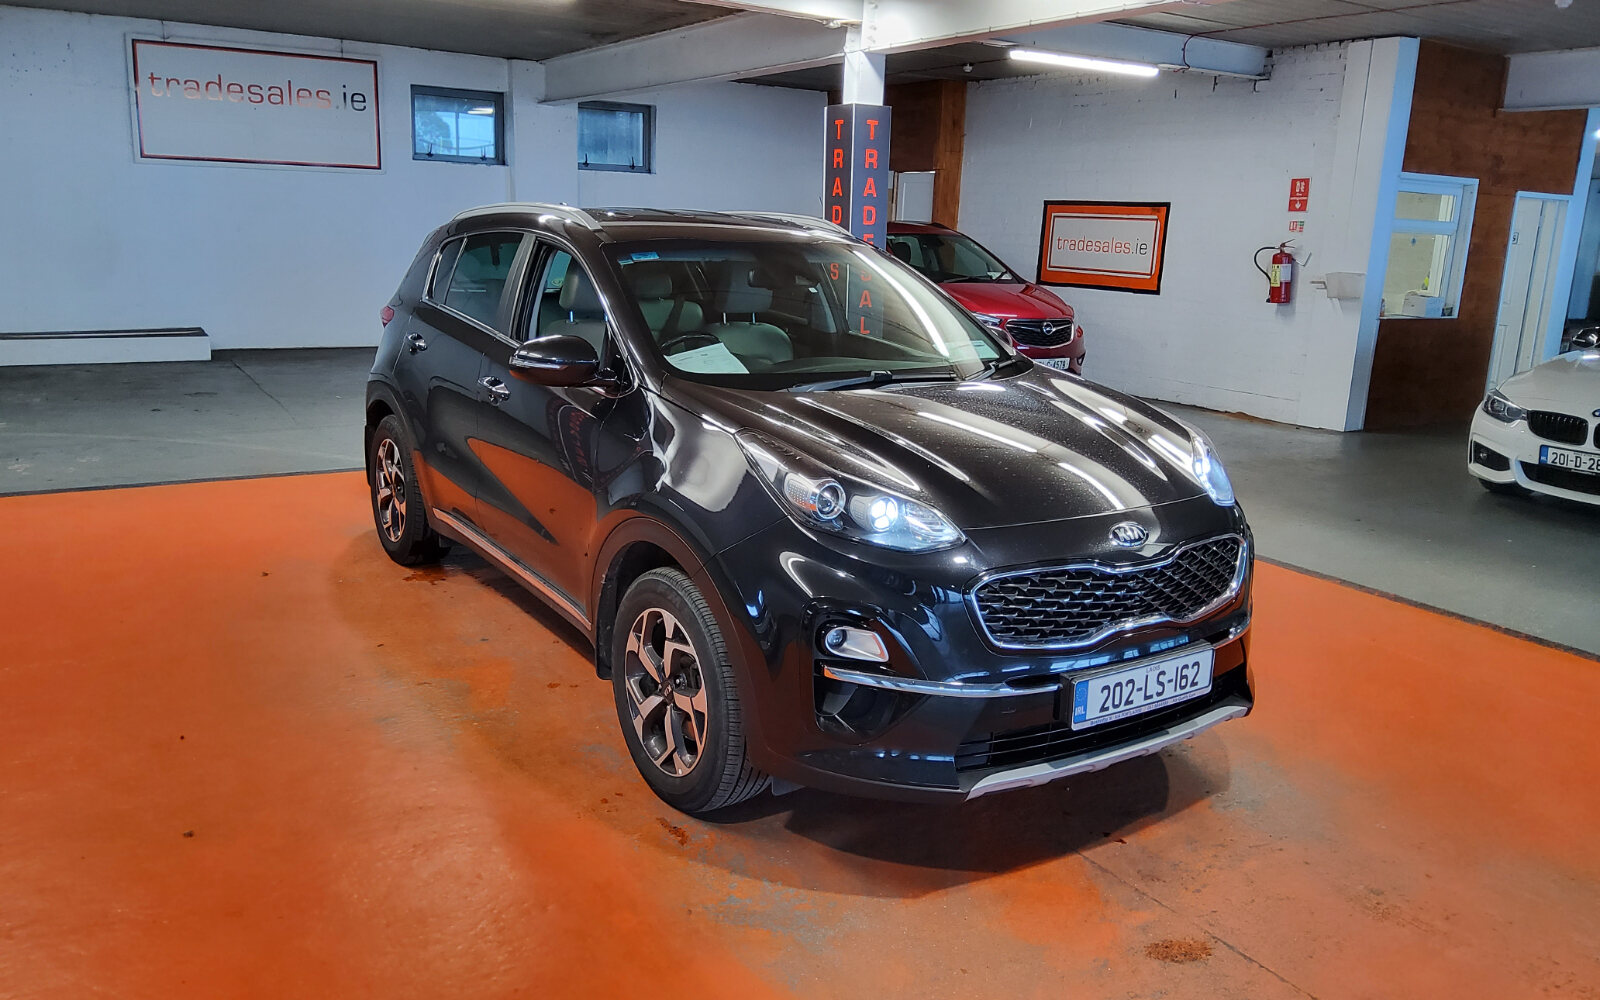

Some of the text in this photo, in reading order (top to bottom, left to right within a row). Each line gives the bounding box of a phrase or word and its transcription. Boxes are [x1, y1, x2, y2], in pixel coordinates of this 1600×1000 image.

[148, 72, 367, 112] tradesales.ie
[1057, 235, 1148, 256] tradesales.ie
[1099, 661, 1200, 713] 202-LS-162
[1074, 705, 1086, 717] IRL
